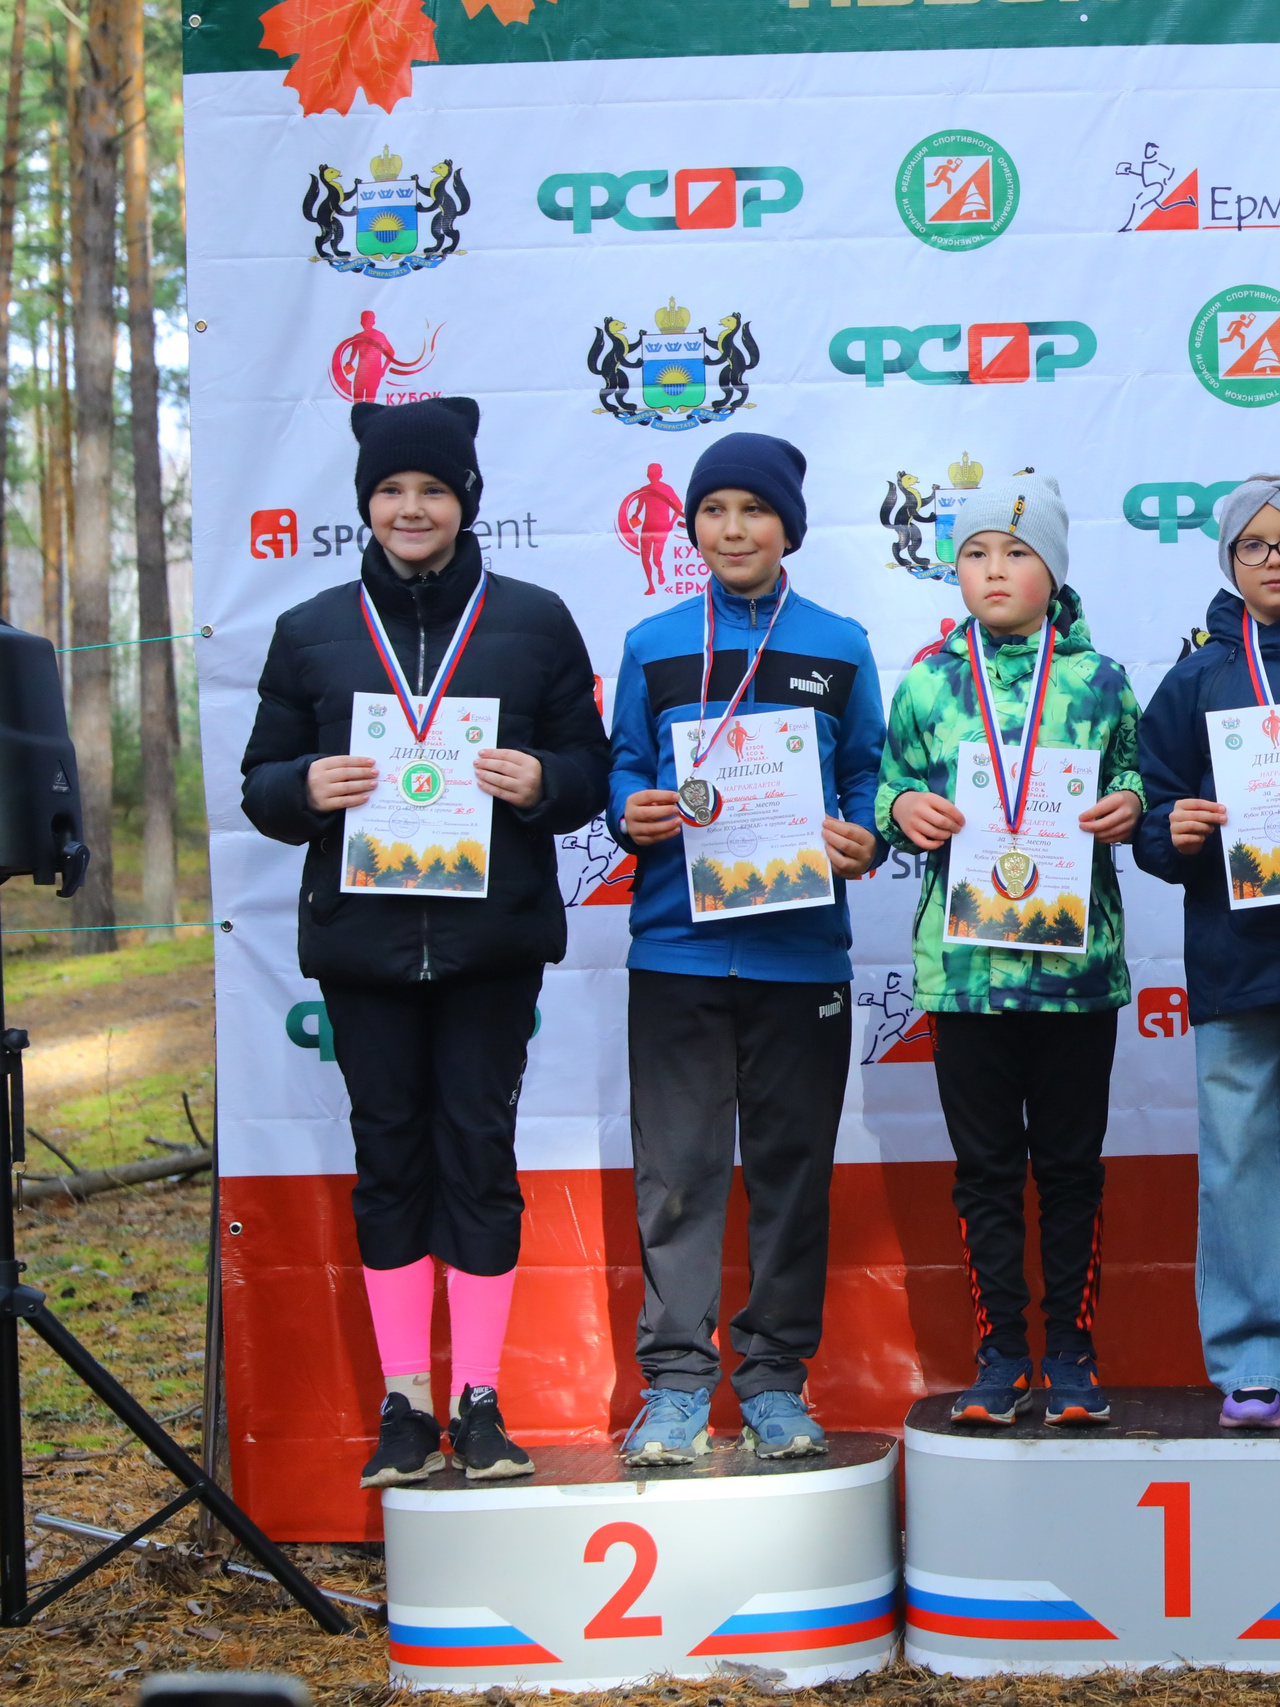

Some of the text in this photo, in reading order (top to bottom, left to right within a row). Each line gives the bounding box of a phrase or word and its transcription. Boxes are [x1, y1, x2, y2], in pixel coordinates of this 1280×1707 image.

[901, 135, 1015, 246] ФЕДЕРАЦИЯ СПОРТИВНОГО ОРИЕНТИРОВАНИЯ ТЮМЕНСКОЙ ОБЛАСТИ
[1194, 301, 1222, 349] ФЕДЕРАЦИЯ
[1195, 354, 1220, 389] ОБЛАСТИ
[1225, 389, 1280, 402] ТЮМЕНСКОЙ
[674, 563, 710, 577] КСО
[790, 677, 824, 695] PUMA
[389, 747, 460, 760] ДИПЛОМ
[716, 761, 784, 781] ДИПЛОМ
[723, 781, 781, 793] НАГРАЖДАЕТСЯ
[1026, 838, 1051, 846] место
[819, 1001, 841, 1018] PUMA
[1136, 1482, 1191, 1618] 1
[583, 1521, 663, 1639] 2
